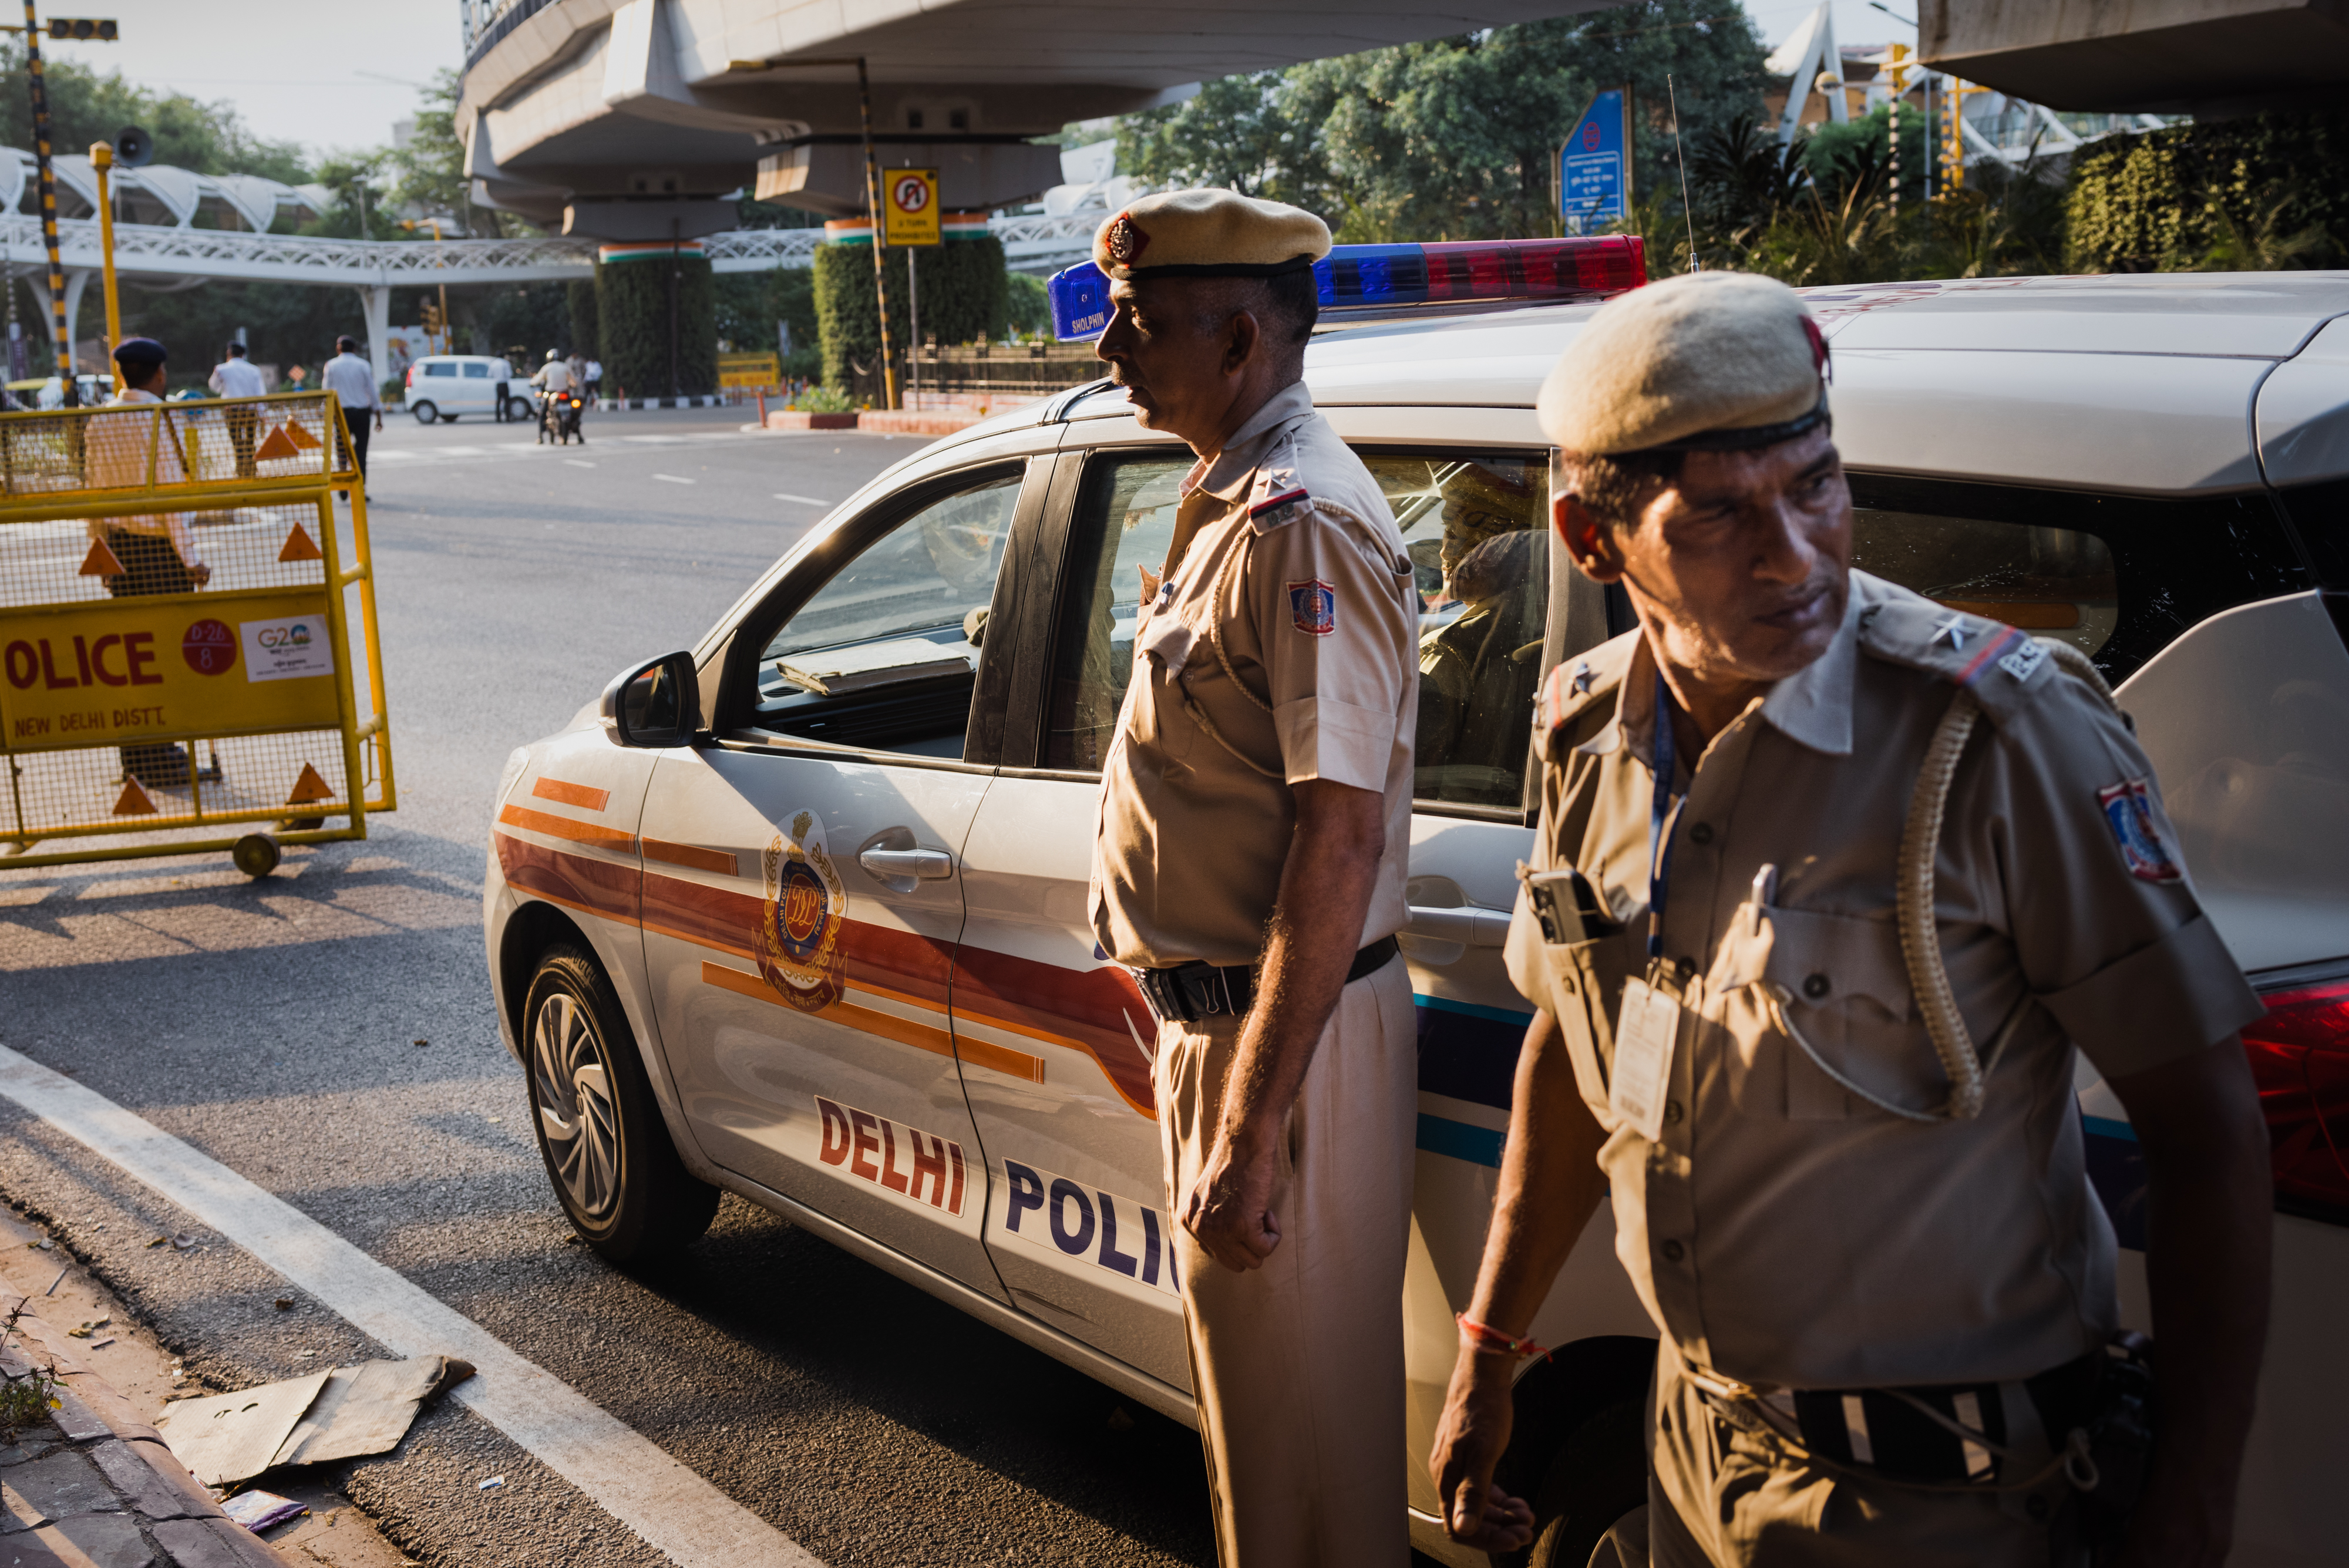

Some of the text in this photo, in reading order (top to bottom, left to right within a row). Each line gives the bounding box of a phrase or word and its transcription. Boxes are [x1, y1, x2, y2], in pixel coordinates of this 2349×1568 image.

[1072, 312, 1105, 334] SHOLPHIN
[201, 647, 212, 669] 8
[14, 716, 51, 738] NEW
[60, 711, 106, 732] DELHI
[779, 872, 790, 939] DELHI POLICE
[816, 1096, 1181, 1294] DELHI POLI
